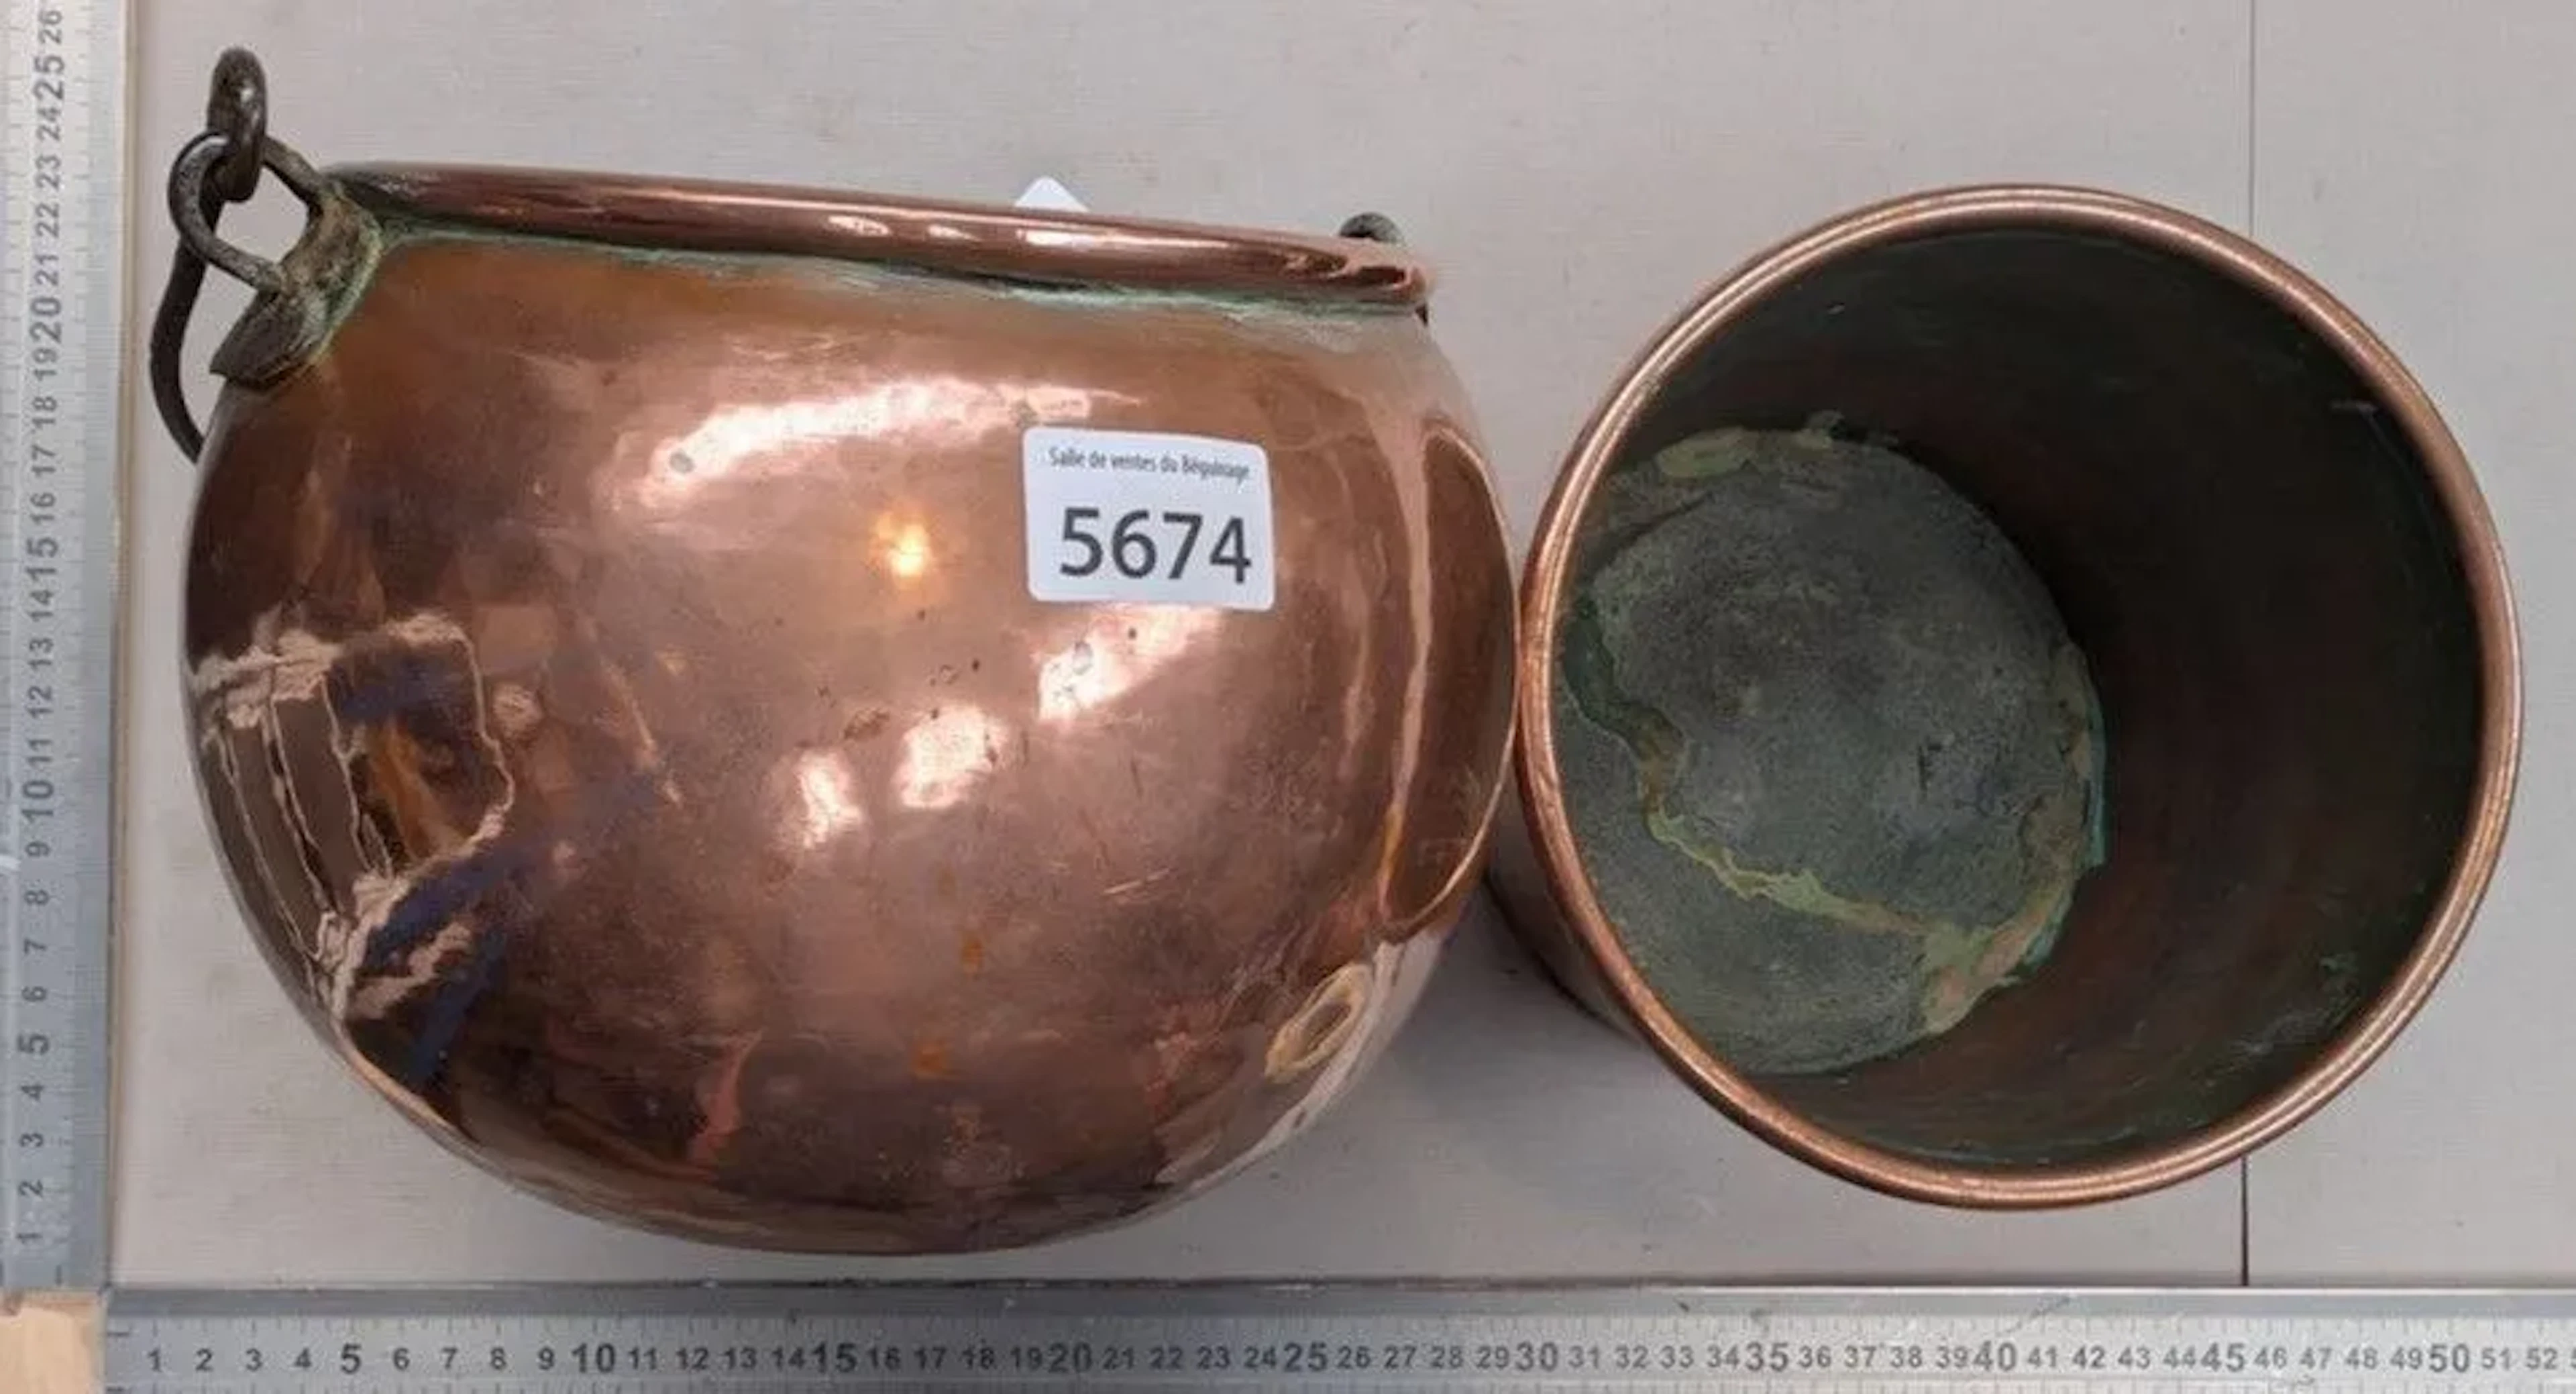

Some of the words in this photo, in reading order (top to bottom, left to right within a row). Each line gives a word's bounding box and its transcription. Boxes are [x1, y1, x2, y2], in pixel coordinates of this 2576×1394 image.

[40, 10, 62, 44] 26
[34, 55, 65, 101] 25
[38, 107, 62, 142] 24
[37, 156, 60, 190] 23
[38, 203, 60, 237] 22
[38, 254, 58, 286] 21
[31, 297, 62, 343] 20
[34, 347, 58, 380] 19
[33, 396, 58, 430] 18
[31, 445, 55, 475] 17
[1089, 451, 1106, 468] de
[1112, 453, 1157, 470] ventes
[1161, 455, 1178, 472] du
[31, 493, 56, 524] 16
[28, 538, 58, 579] 15
[1059, 508, 1251, 584] 5674
[30, 590, 54, 623] 14
[29, 638, 54, 670] 13
[28, 686, 54, 718] 12
[27, 739, 52, 766] 11
[23, 780, 54, 822] 10
[25, 841, 50, 857] 9
[24, 890, 49, 905] 8
[24, 939, 48, 953] 7
[22, 987, 46, 1002] 6
[18, 1034, 49, 1055] 5
[21, 1085, 44, 1100] 4
[20, 1133, 44, 1148] 3
[19, 1180, 44, 1198] 2
[17, 1230, 42, 1243] 1
[150, 1348, 161, 1371] 1
[195, 1348, 213, 1371] 2
[245, 1348, 263, 1371] 3
[294, 1348, 311, 1371] 4
[340, 1344, 362, 1373] 5
[393, 1348, 410, 1371] 6
[441, 1348, 458, 1371] 7
[490, 1348, 506, 1371] 8
[538, 1348, 554, 1371] 9
[573, 1344, 616, 1373] 10
[629, 1348, 656, 1371] 11
[676, 1348, 708, 1371] 12
[724, 1348, 756, 1371] 13
[771, 1348, 804, 1371] 14
[814, 1344, 856, 1373] 15
[869, 1348, 901, 1369] 16
[916, 1348, 946, 1369] 17
[963, 1348, 994, 1369] 18
[1012, 1348, 1043, 1369] 19
[1049, 1344, 1092, 1373] 20
[1102, 1348, 1134, 1369] 21
[1149, 1348, 1183, 1369] 22
[1197, 1348, 1230, 1369] 23
[1244, 1348, 1276, 1369] 24
[1283, 1344, 1327, 1373] 25
[1338, 1348, 1371, 1369] 26
[1385, 1348, 1415, 1369] 27
[1431, 1348, 1463, 1369] 28
[1478, 1348, 1509, 1369] 29
[1515, 1344, 1558, 1373] 30
[1569, 1348, 1599, 1369] 31
[1615, 1348, 1647, 1369] 32
[1660, 1348, 1694, 1369] 33
[1707, 1348, 1739, 1369] 34
[1745, 1344, 1788, 1373] 35
[1799, 1348, 1831, 1369] 36
[1845, 1348, 1876, 1369] 37
[1890, 1348, 1922, 1369] 38
[1936, 1348, 1967, 1369] 39
[1972, 1344, 2015, 1373] 40
[2027, 1348, 2058, 1369] 41
[2072, 1348, 2105, 1369] 42
[2118, 1348, 2149, 1369] 43
[2163, 1348, 2196, 1369] 44
[2201, 1344, 2245, 1373] 45
[2253, 1348, 2286, 1369] 46
[2300, 1348, 2332, 1369] 47
[2345, 1348, 2378, 1369] 48
[2390, 1348, 2422, 1369] 49
[2429, 1344, 2471, 1373] 50
[2481, 1348, 2511, 1369] 51
[2527, 1348, 2557, 1369] 52
